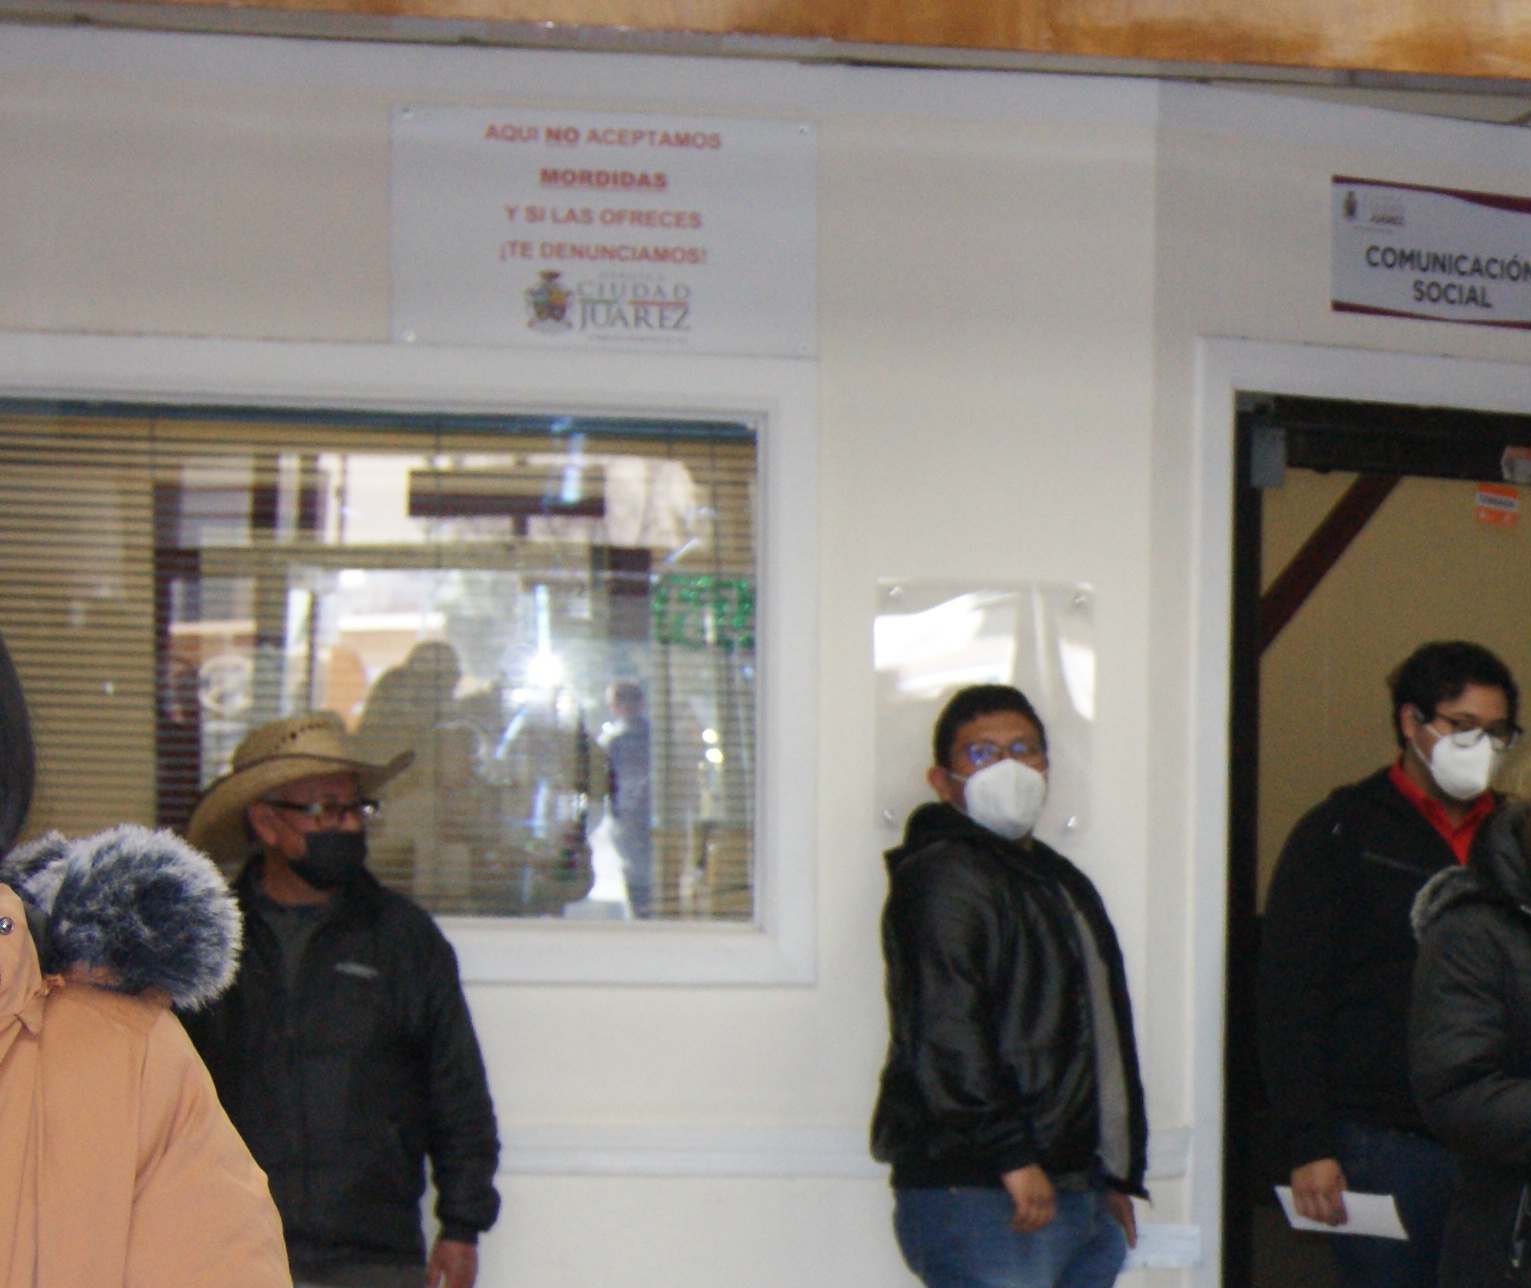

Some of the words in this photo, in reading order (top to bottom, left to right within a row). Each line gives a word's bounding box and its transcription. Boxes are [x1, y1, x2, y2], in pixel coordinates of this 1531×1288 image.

[545, 127, 580, 146] NO
[586, 128, 722, 149] ACEPTAMOS
[539, 167, 668, 190] MORDIDAS
[506, 205, 519, 221] Y
[525, 206, 546, 222] SI
[551, 208, 594, 225] LAS
[599, 209, 701, 229] OFRECES
[540, 242, 707, 265] DENUNCIAMOS!
[577, 280, 690, 299] CIUDAD
[1413, 279, 1492, 308] SOCIAL
